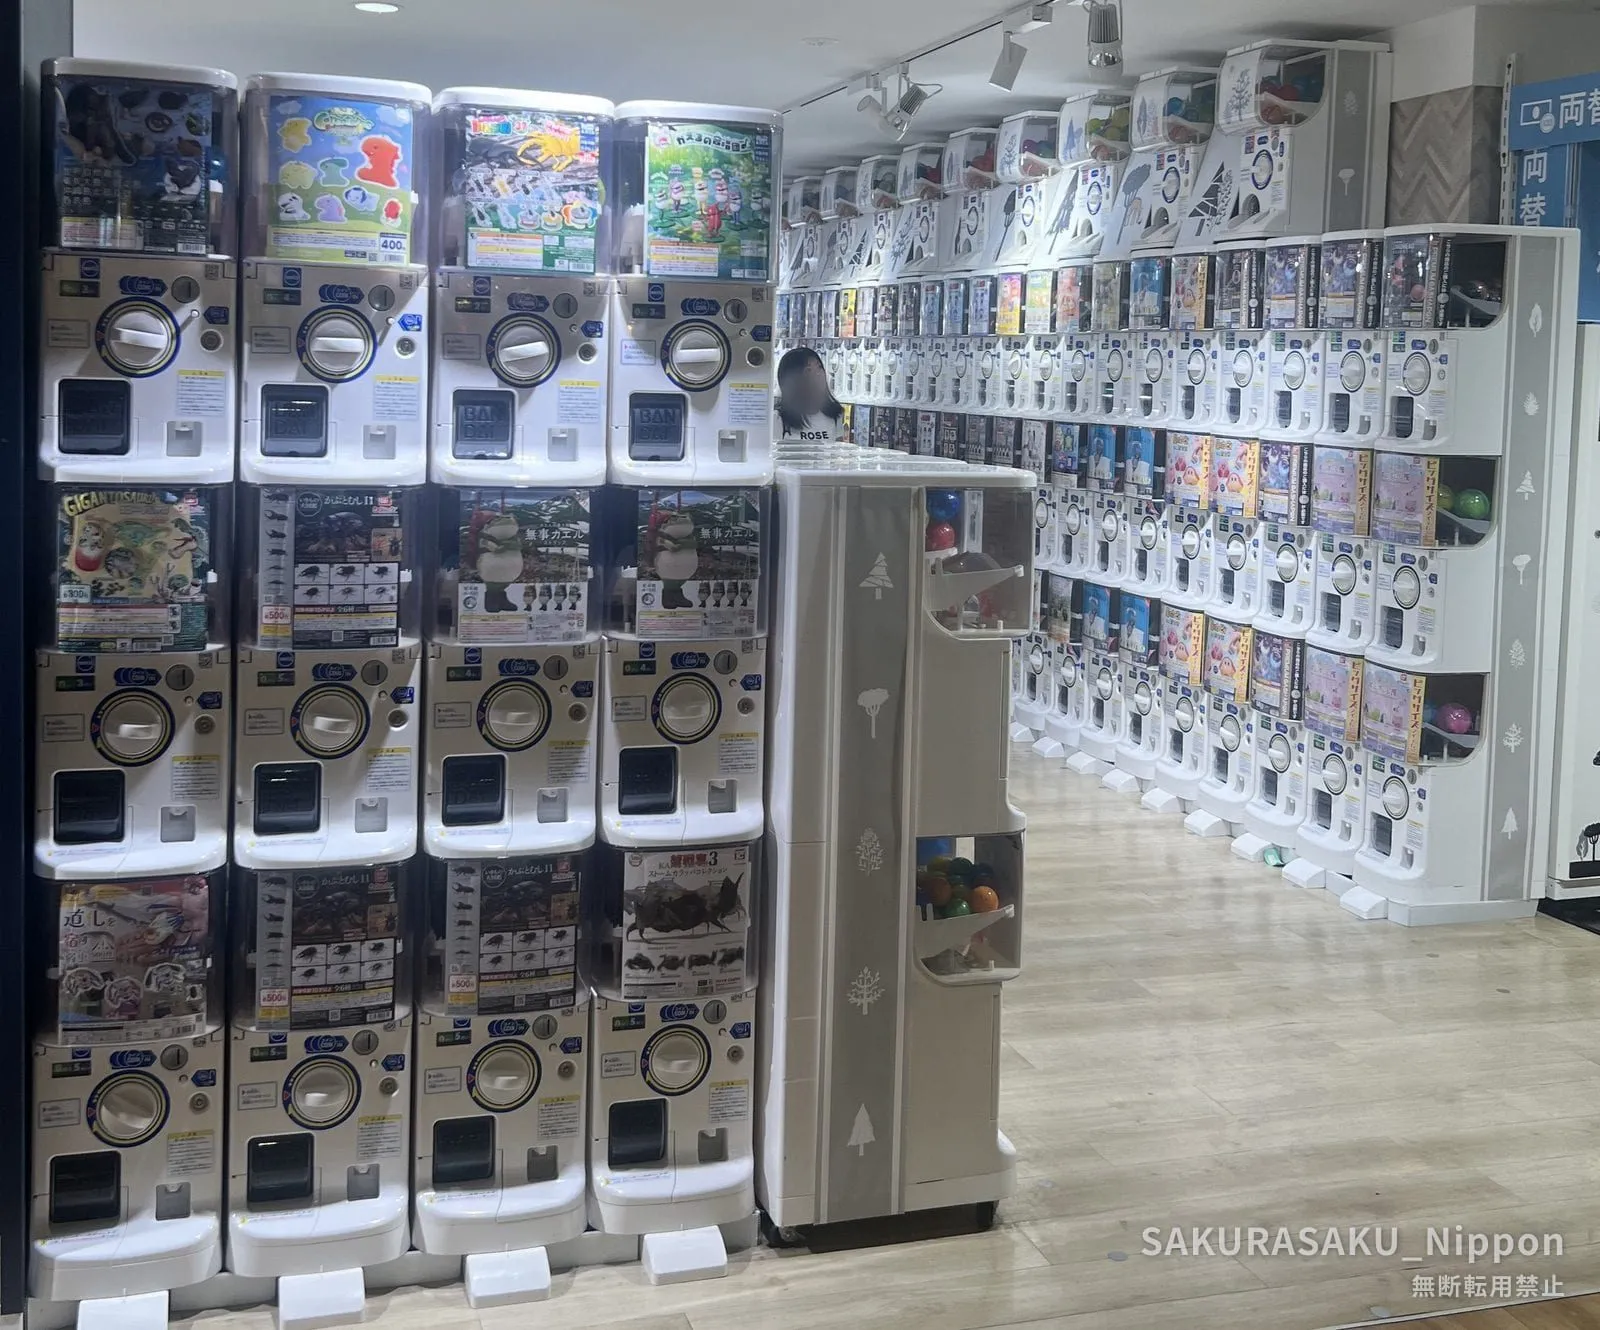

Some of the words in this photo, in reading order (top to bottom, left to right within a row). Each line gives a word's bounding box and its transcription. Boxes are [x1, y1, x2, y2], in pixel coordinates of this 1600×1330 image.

[1519, 150, 1547, 227] 両替
[801, 431, 829, 440] ROSE
[524, 528, 584, 540] 無事カエル
[699, 527, 754, 539] 無事カエル
